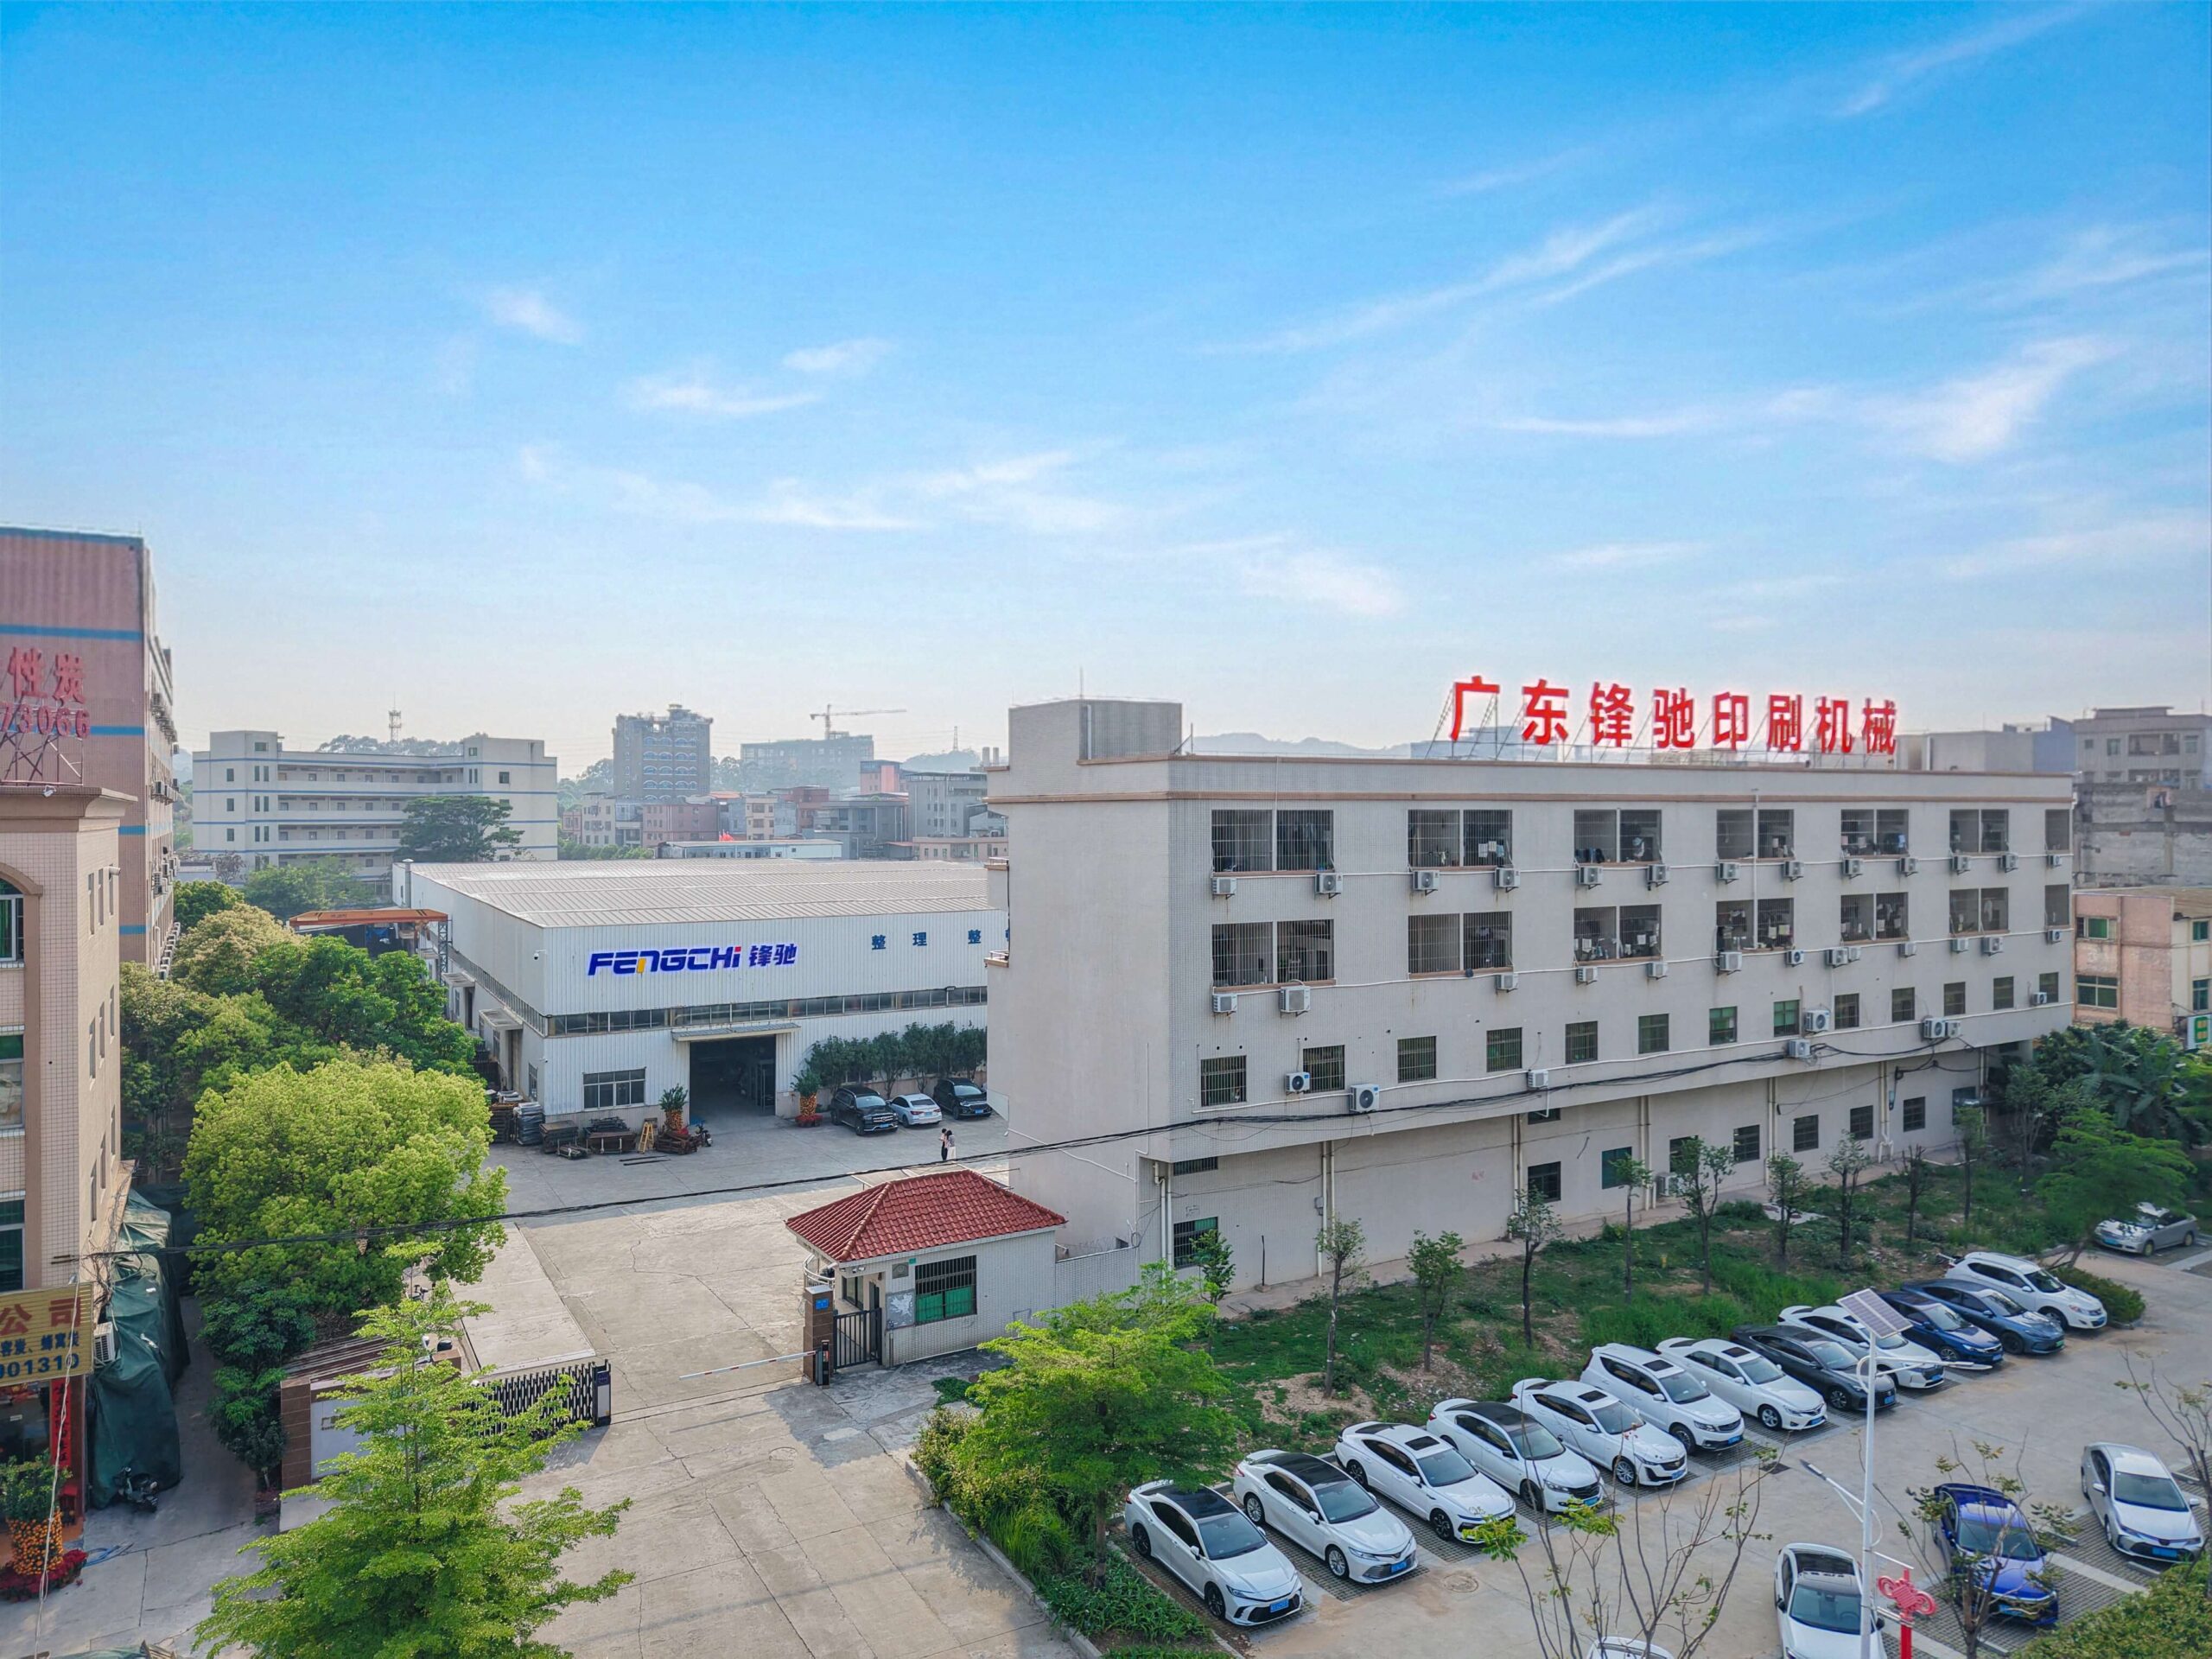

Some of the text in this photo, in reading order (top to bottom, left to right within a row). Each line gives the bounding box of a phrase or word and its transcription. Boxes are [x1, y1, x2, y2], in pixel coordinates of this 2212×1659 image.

[0, 646, 86, 704] 性炭
[1450, 676, 1897, 754] 广东锋驰印刷机械
[748, 943, 798, 968] 锋驰
[0, 1297, 81, 1336] 公司
